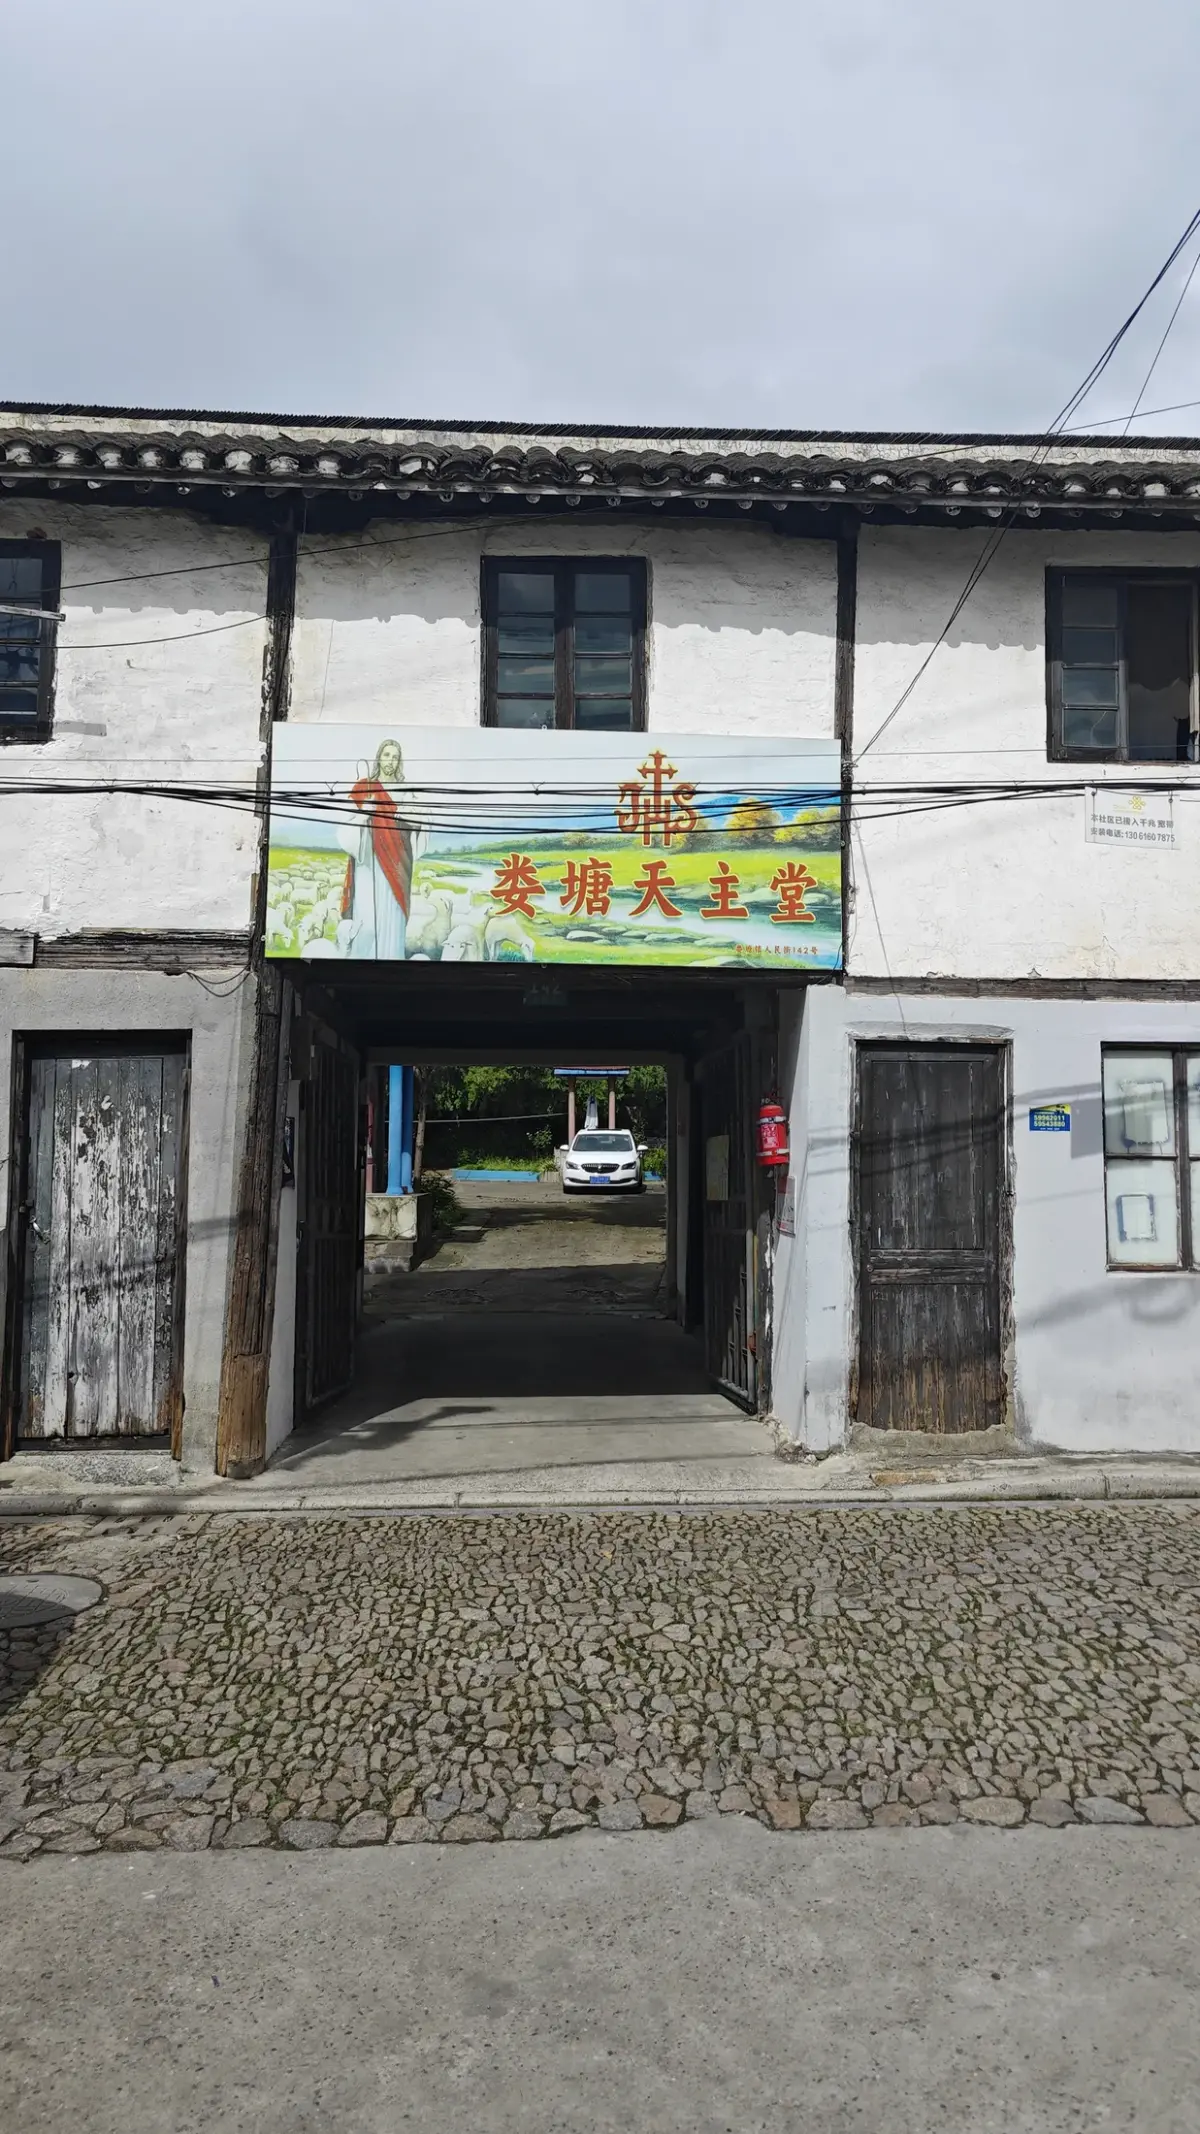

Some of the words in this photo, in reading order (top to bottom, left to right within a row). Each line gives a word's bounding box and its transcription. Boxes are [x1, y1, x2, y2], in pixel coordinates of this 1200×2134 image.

[490, 853, 818, 924] 娄塘天主堂
